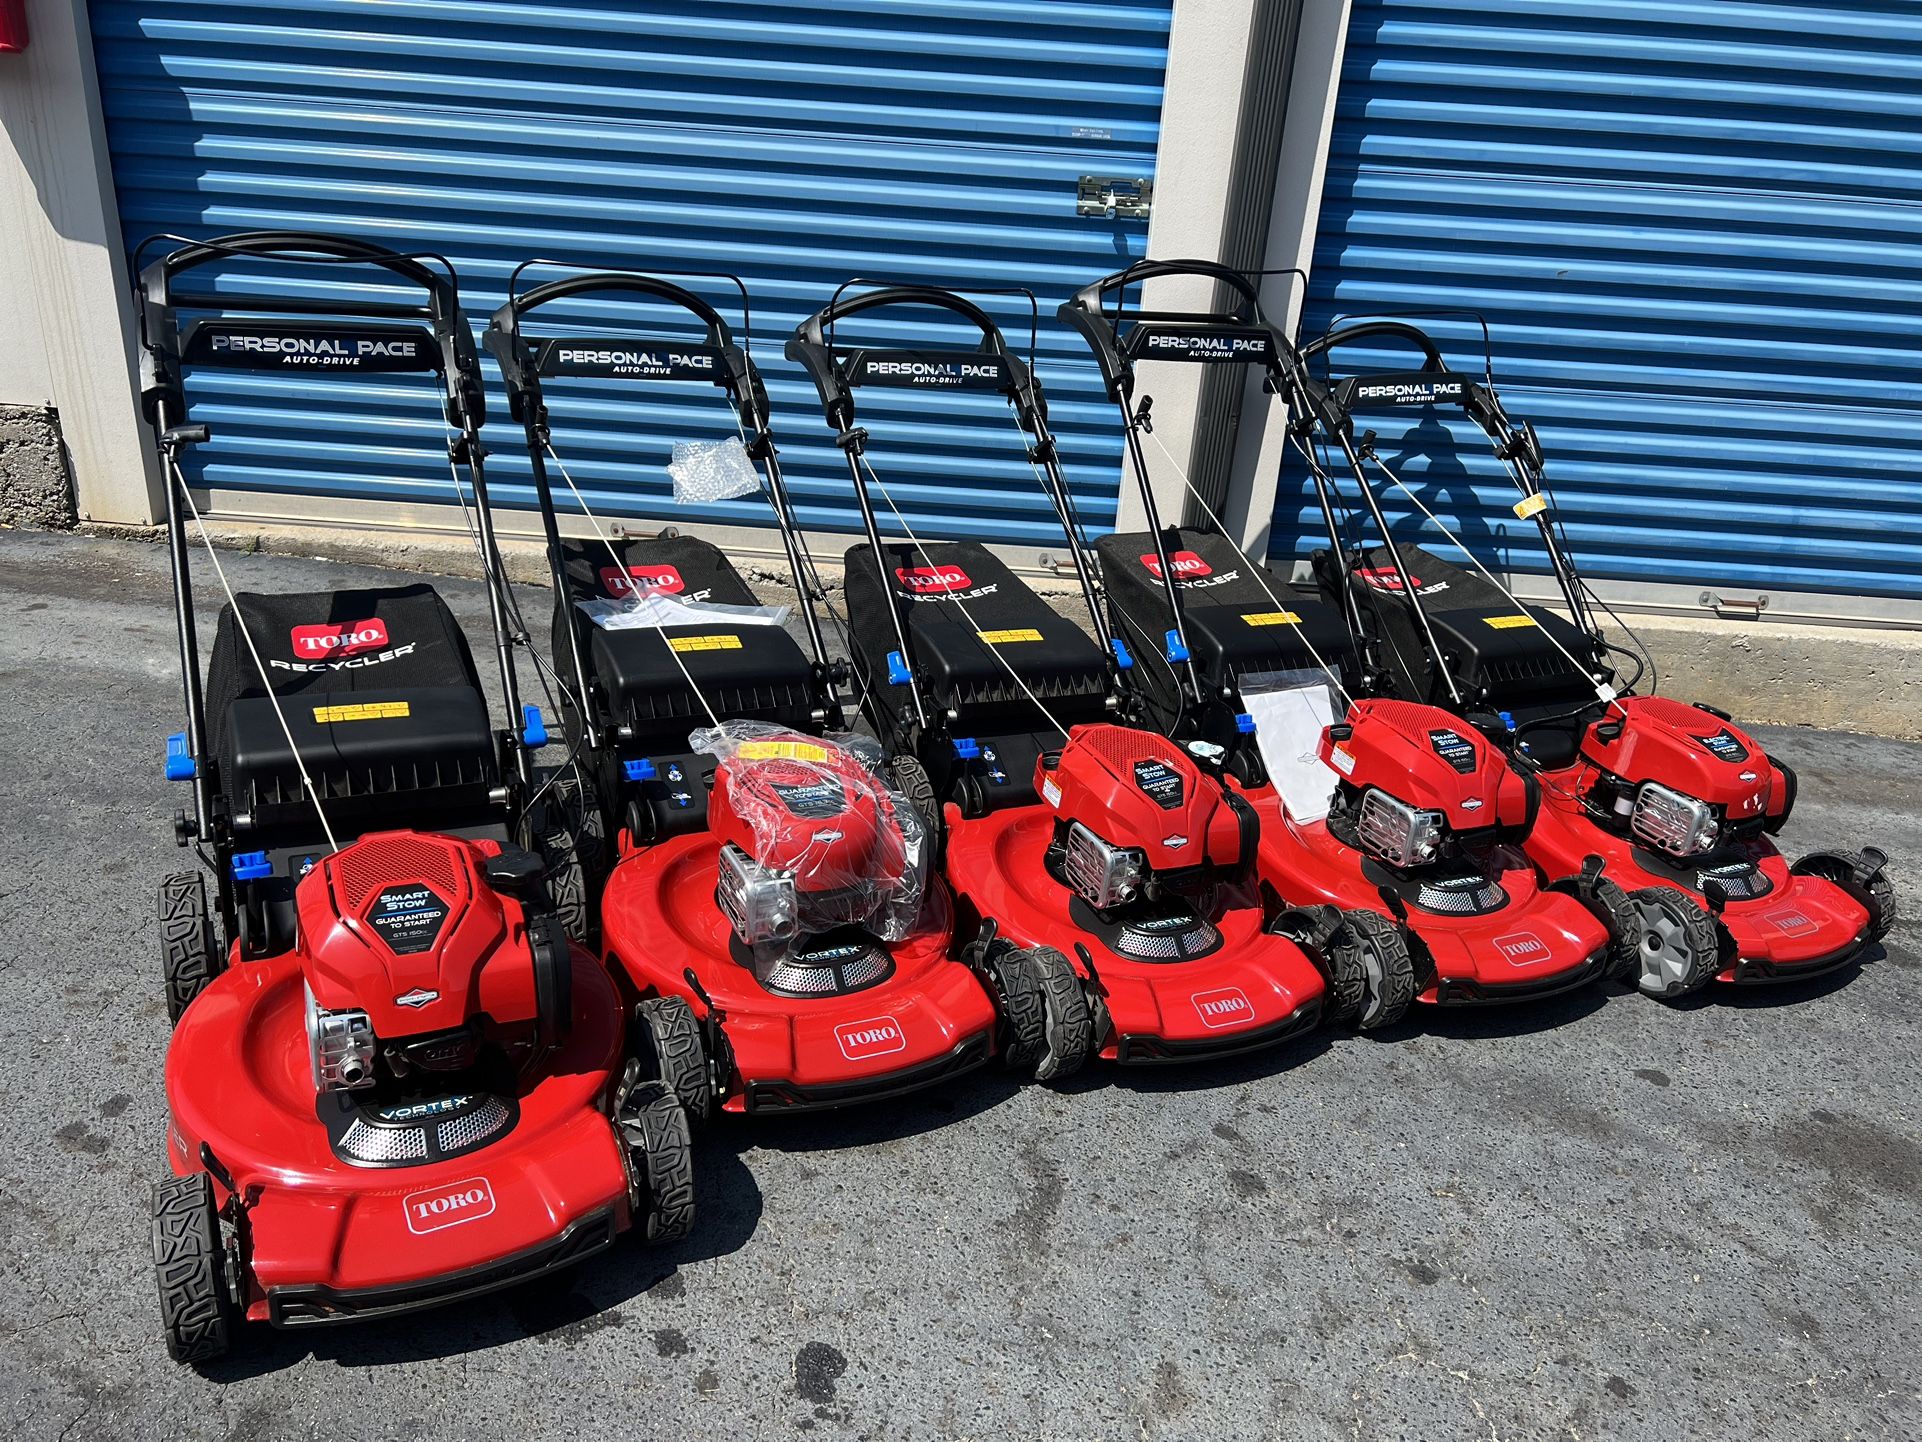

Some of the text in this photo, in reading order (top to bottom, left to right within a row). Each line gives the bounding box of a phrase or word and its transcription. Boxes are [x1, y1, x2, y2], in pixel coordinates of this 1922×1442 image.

[211, 335, 416, 357] PERSONAL PACE
[1148, 335, 1266, 352] PERSONAL PACE
[282, 355, 361, 365] AUTO-DRIVE
[558, 349, 714, 369] PERSONAL PACE
[1188, 350, 1234, 358] AUTO-DRIVE
[612, 365, 672, 375] AUTO-DRIVE
[866, 361, 998, 378] PERSONAL PACE
[912, 376, 963, 384] AUTO-DRIVE
[1358, 383, 1462, 398] PERSONAL PACE
[1395, 395, 1436, 403] AUTO-DRIVE
[608, 574, 676, 591] TORO
[904, 573, 962, 587] TORO
[896, 583, 999, 603] RECYCLER
[300, 629, 381, 651] TORO
[269, 641, 417, 673] RECYCLER
[1435, 876, 1484, 887] VORTEX
[380, 890, 431, 904] SMART
[386, 899, 427, 911] STOW
[375, 911, 442, 925] GUARANTEED
[390, 918, 431, 929] TO START
[1136, 915, 1190, 929] VORTEX
[793, 945, 860, 961] VORTEX
[1503, 940, 1542, 956] TORO
[1200, 997, 1246, 1016] TORO
[844, 1026, 897, 1048] TORO
[378, 1094, 469, 1120] VORTEX
[413, 1188, 486, 1220] TORO
